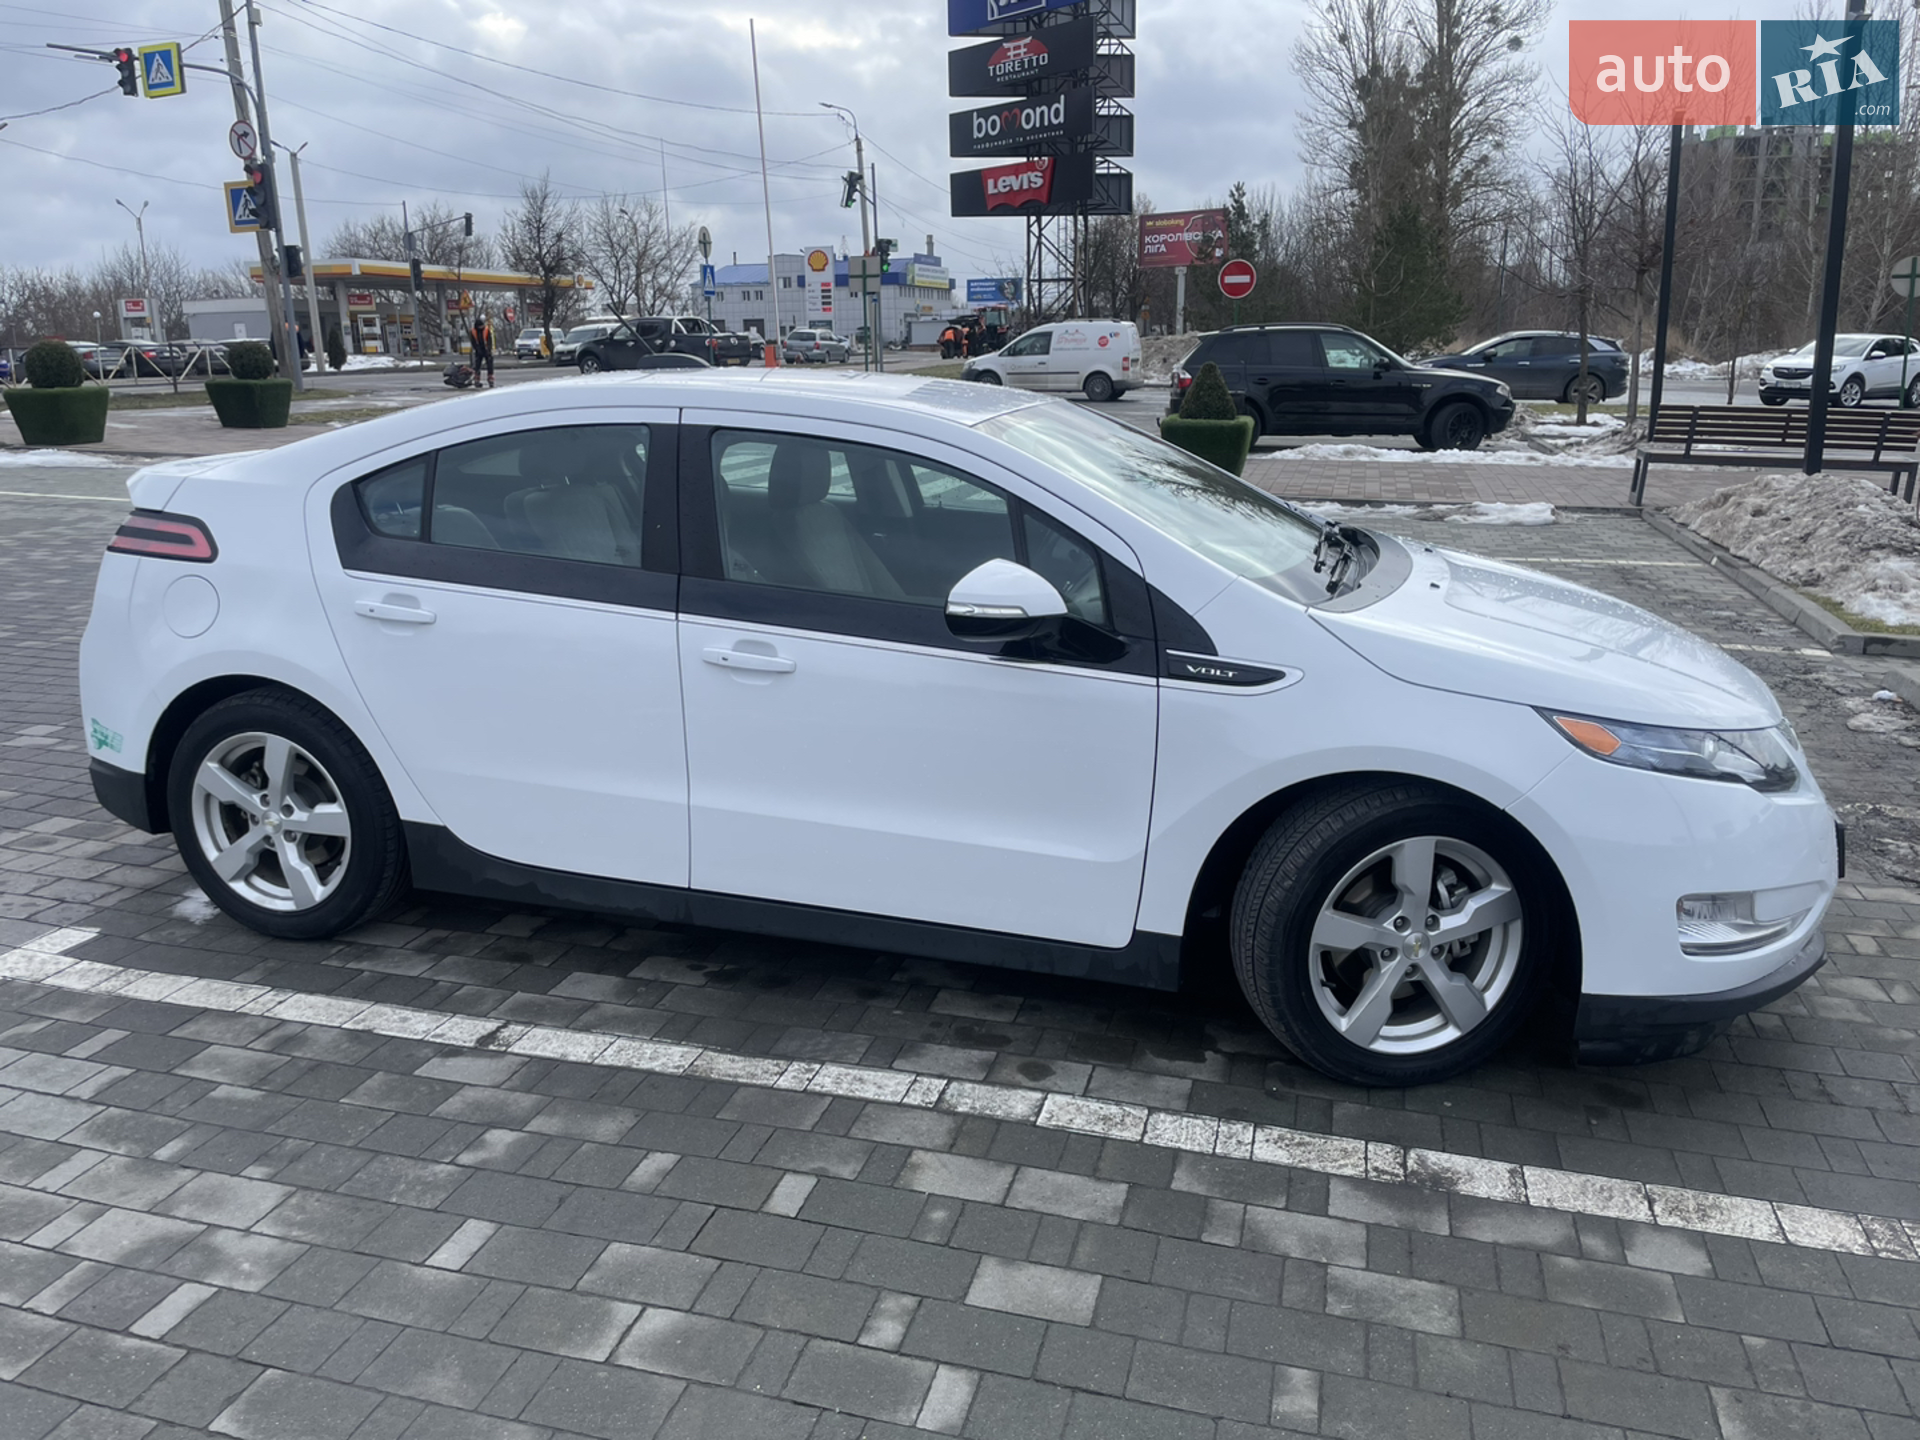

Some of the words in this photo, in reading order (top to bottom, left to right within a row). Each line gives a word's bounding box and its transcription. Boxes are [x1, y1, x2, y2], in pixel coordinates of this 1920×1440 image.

[988, 53, 1049, 77] TORETTO
[996, 69, 1040, 82] RESTAURANT
[1144, 243, 1167, 254] ЛІГА
[1186, 664, 1238, 678] VOLT
